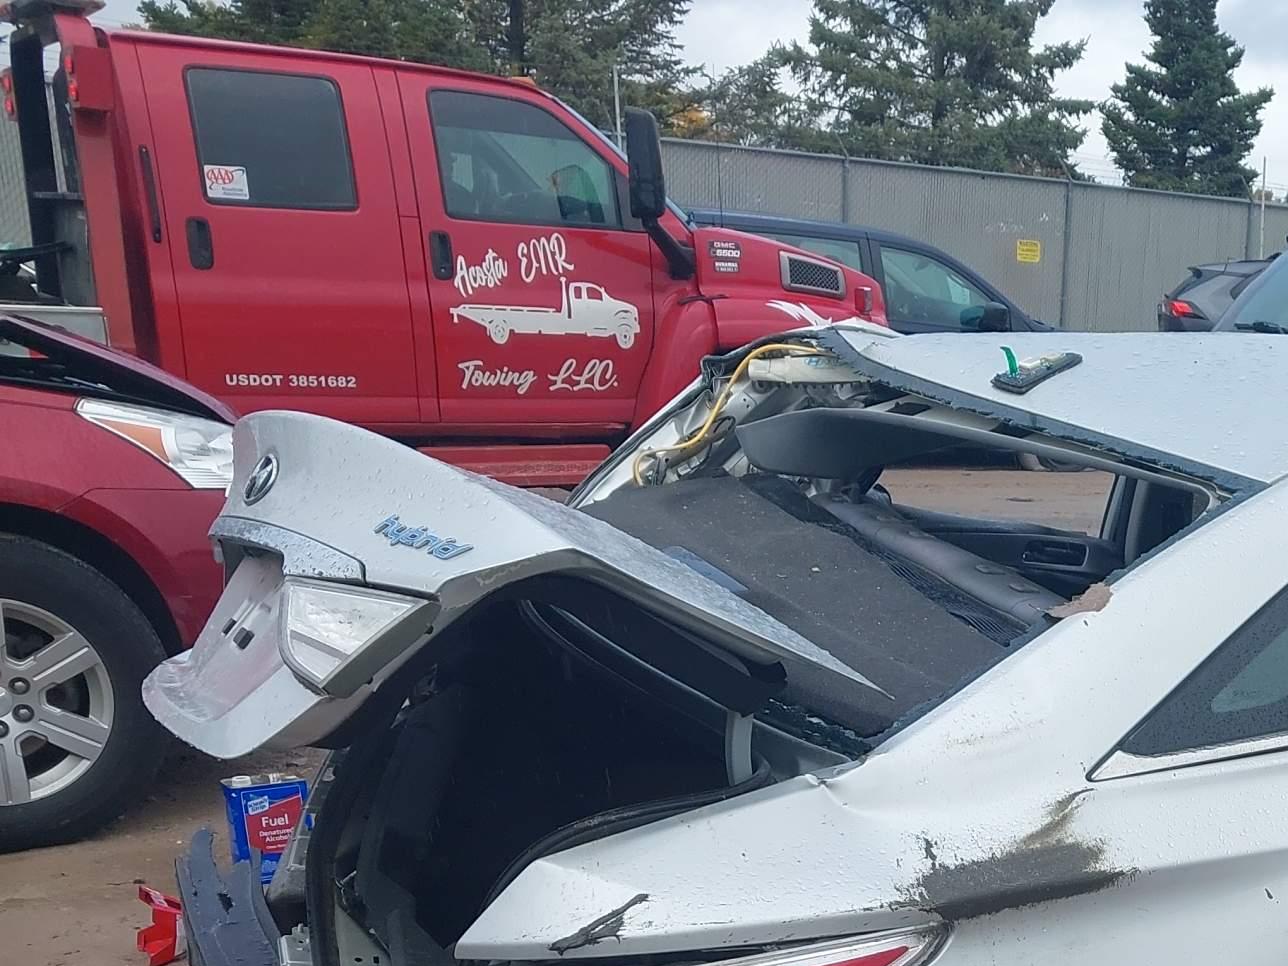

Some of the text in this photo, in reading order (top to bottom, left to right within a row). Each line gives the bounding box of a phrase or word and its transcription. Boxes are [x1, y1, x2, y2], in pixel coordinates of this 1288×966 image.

[208, 168, 233, 185] AAA
[454, 249, 508, 298] Acosta
[225, 374, 357, 388] USDOT 3851682
[458, 360, 538, 395] Towing
[374, 513, 475, 561] hybrid
[261, 813, 289, 828] Fuel
